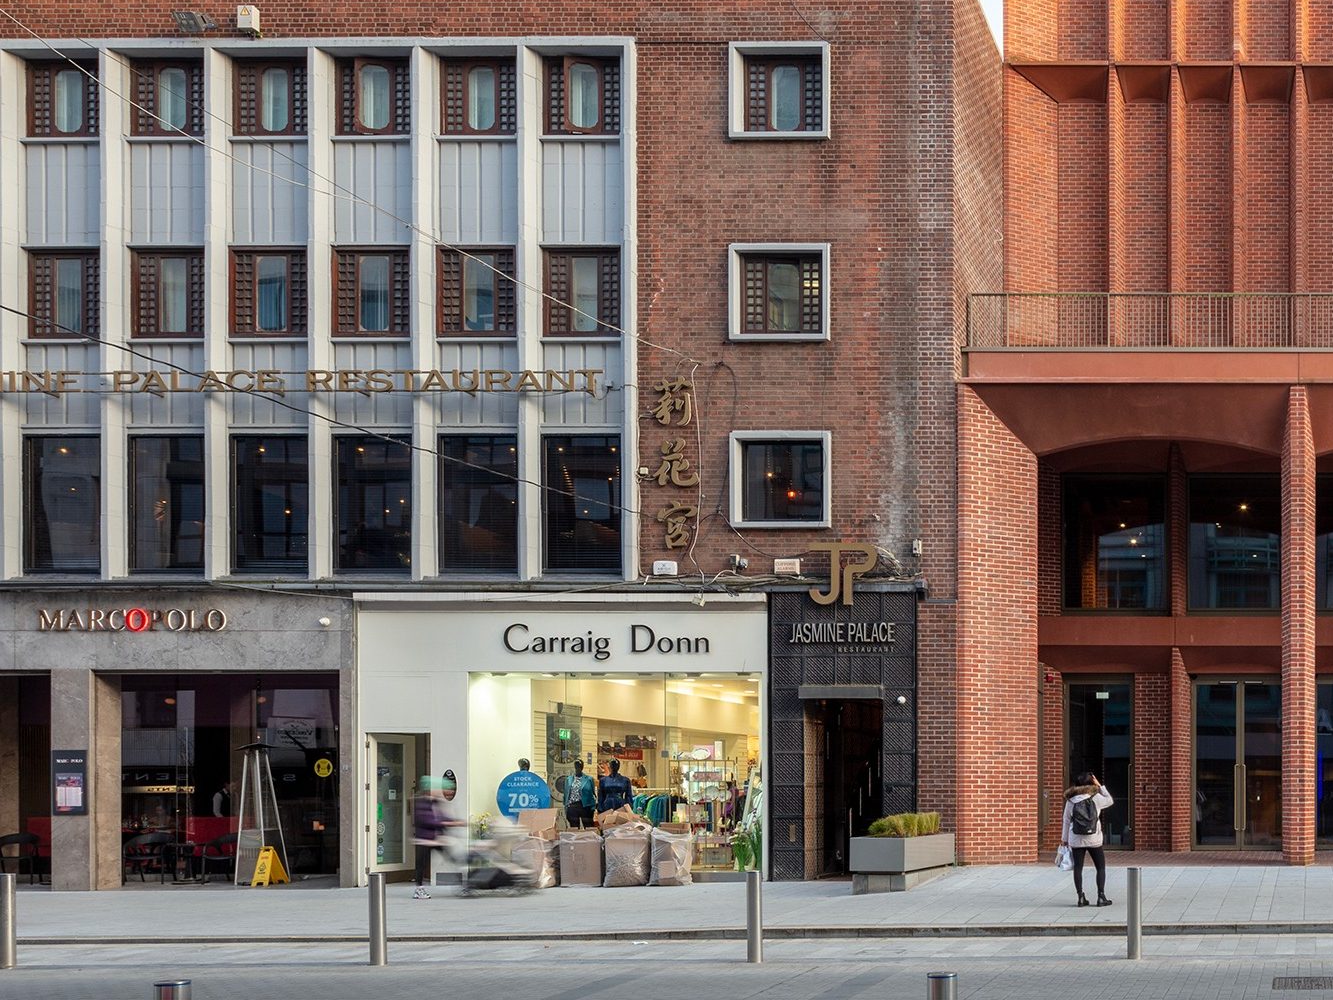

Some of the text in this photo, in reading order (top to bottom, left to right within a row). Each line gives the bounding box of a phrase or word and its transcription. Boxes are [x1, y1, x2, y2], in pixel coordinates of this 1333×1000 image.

[0, 369, 603, 393] INE PALACE RESTAURANT
[808, 542, 877, 606] JP
[503, 623, 710, 661] Carraig Donn
[789, 622, 896, 643] JASMINE PALACE
